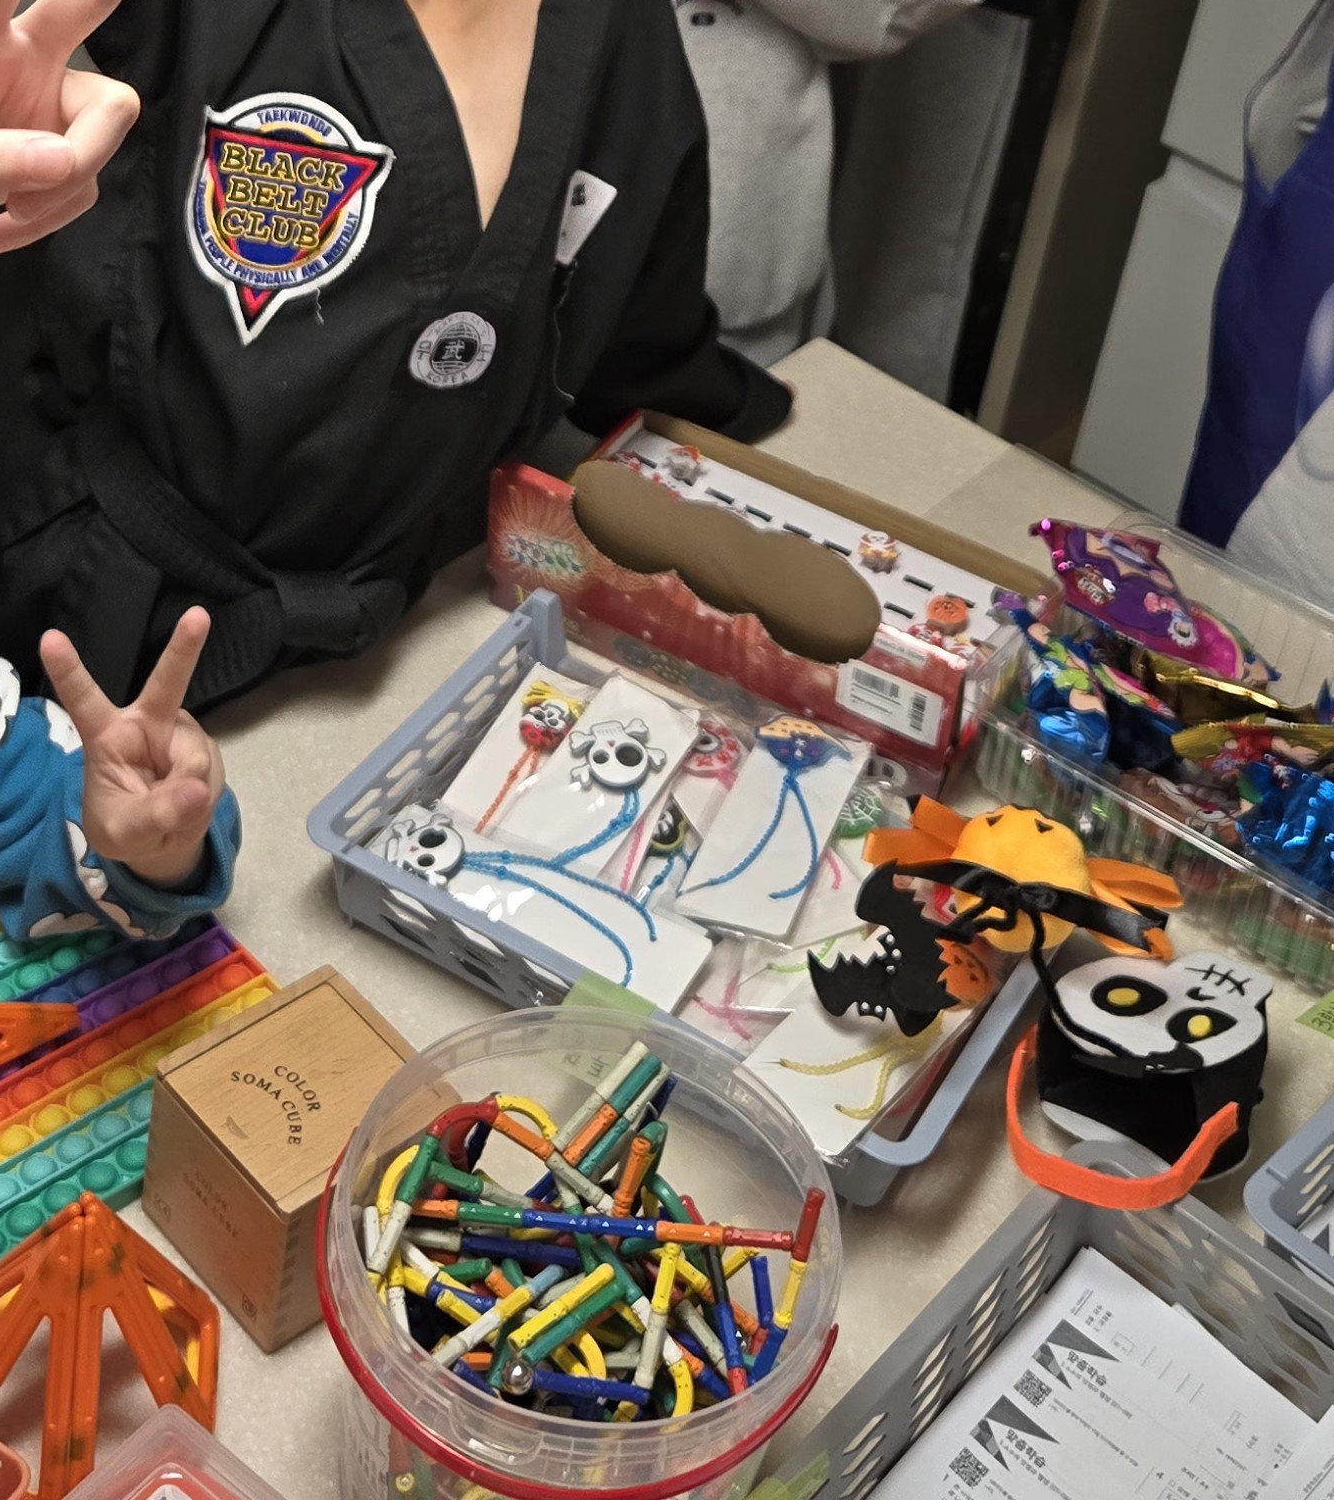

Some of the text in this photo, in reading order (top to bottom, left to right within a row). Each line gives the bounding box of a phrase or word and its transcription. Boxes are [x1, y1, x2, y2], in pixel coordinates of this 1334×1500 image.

[257, 109, 332, 138] TAEKWONDO
[220, 142, 348, 194] BLACK
[226, 174, 329, 219] BELT
[204, 211, 360, 286] PEOPLE PHYSICALLY AND MENTALLY
[221, 207, 321, 248] CLUB
[231, 1069, 303, 1145] SOMA CUBE
[273, 1064, 321, 1112] COLOR
